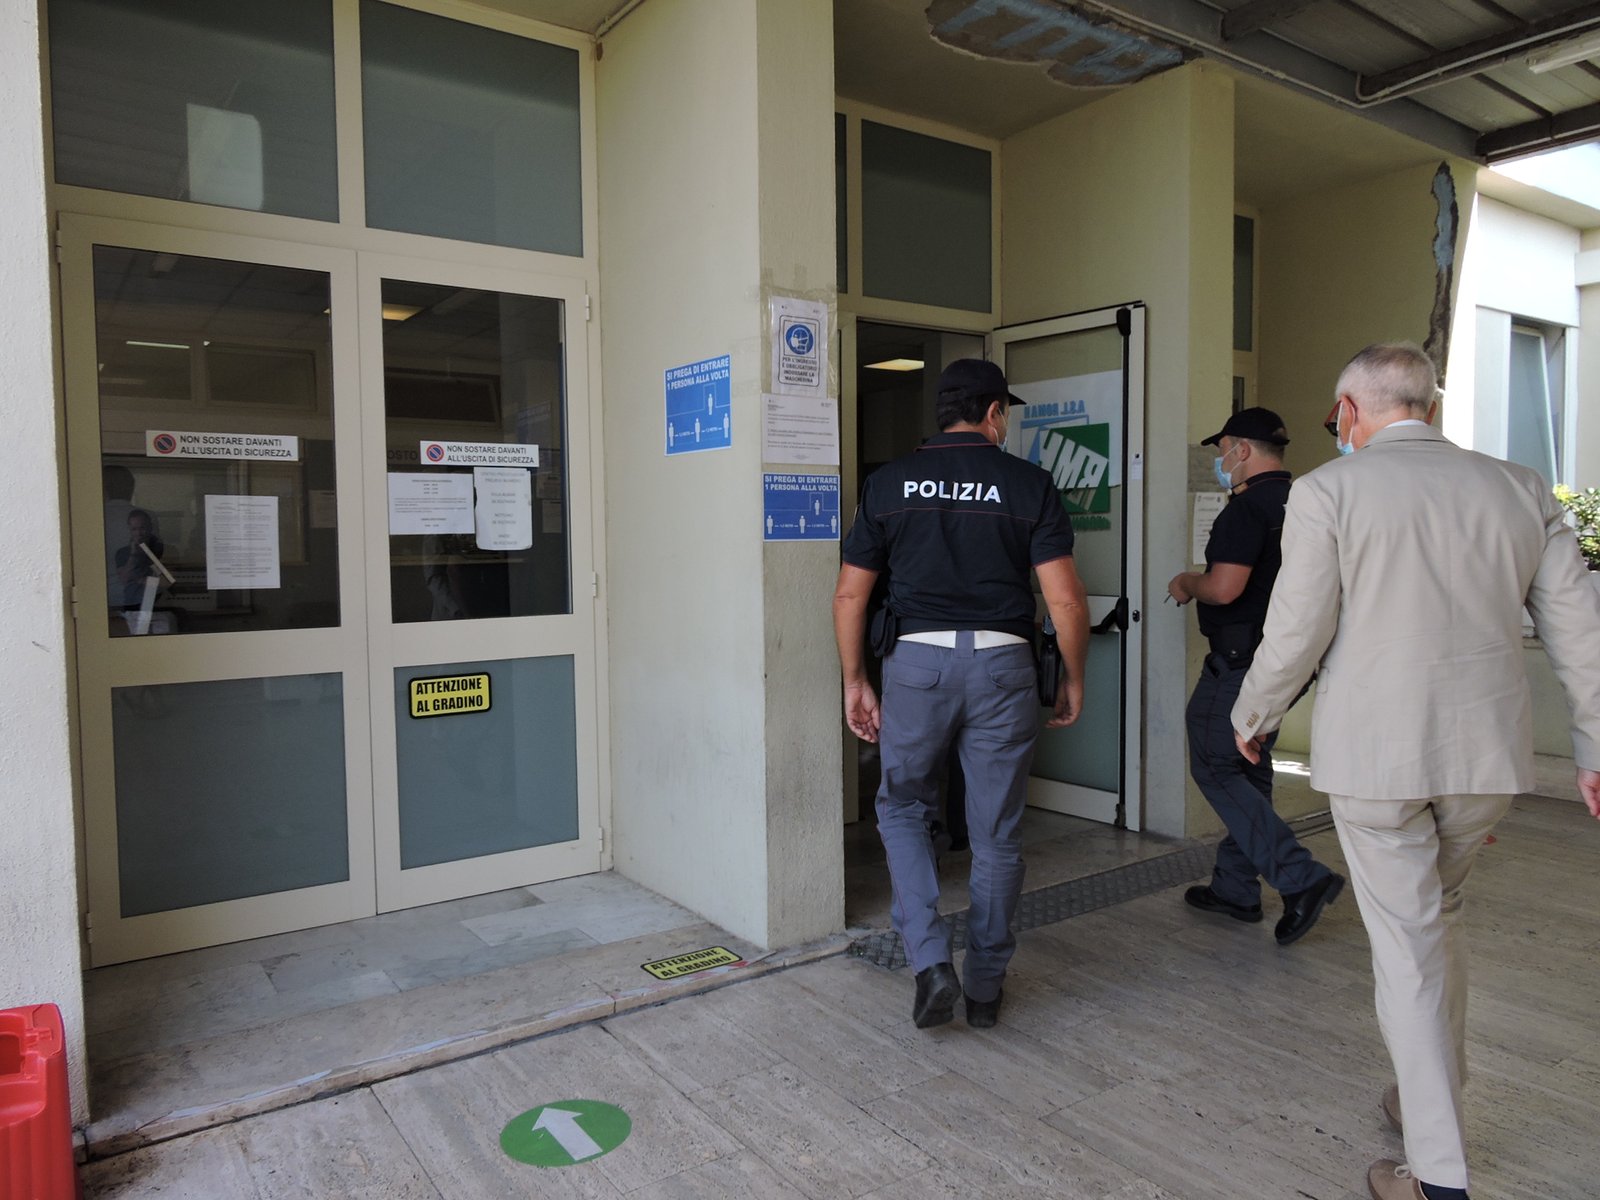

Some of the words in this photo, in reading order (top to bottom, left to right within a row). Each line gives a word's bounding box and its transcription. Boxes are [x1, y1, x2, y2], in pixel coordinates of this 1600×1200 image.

[666, 372, 672, 380] SI
[674, 366, 692, 379] PREGA
[693, 365, 700, 374] DI
[700, 358, 729, 372] ENTRARE
[671, 376, 694, 390] PERSONA
[696, 374, 710, 384] ALLA
[710, 369, 729, 380] VOLTA
[180, 436, 200, 444] NON
[202, 436, 243, 446] SOSTARE
[246, 438, 282, 446] DAVANTI
[181, 446, 232, 455] ALL'USCITA
[244, 449, 292, 457] SICUREZZA
[904, 480, 1001, 504] POLIZIA
[416, 678, 482, 694] ATTENZIONE
[416, 700, 430, 712] AL
[432, 695, 483, 711] GRADINO
[650, 949, 720, 970] ATTENZIONE
[660, 969, 678, 977] AL
[676, 956, 732, 972] GRADINO
